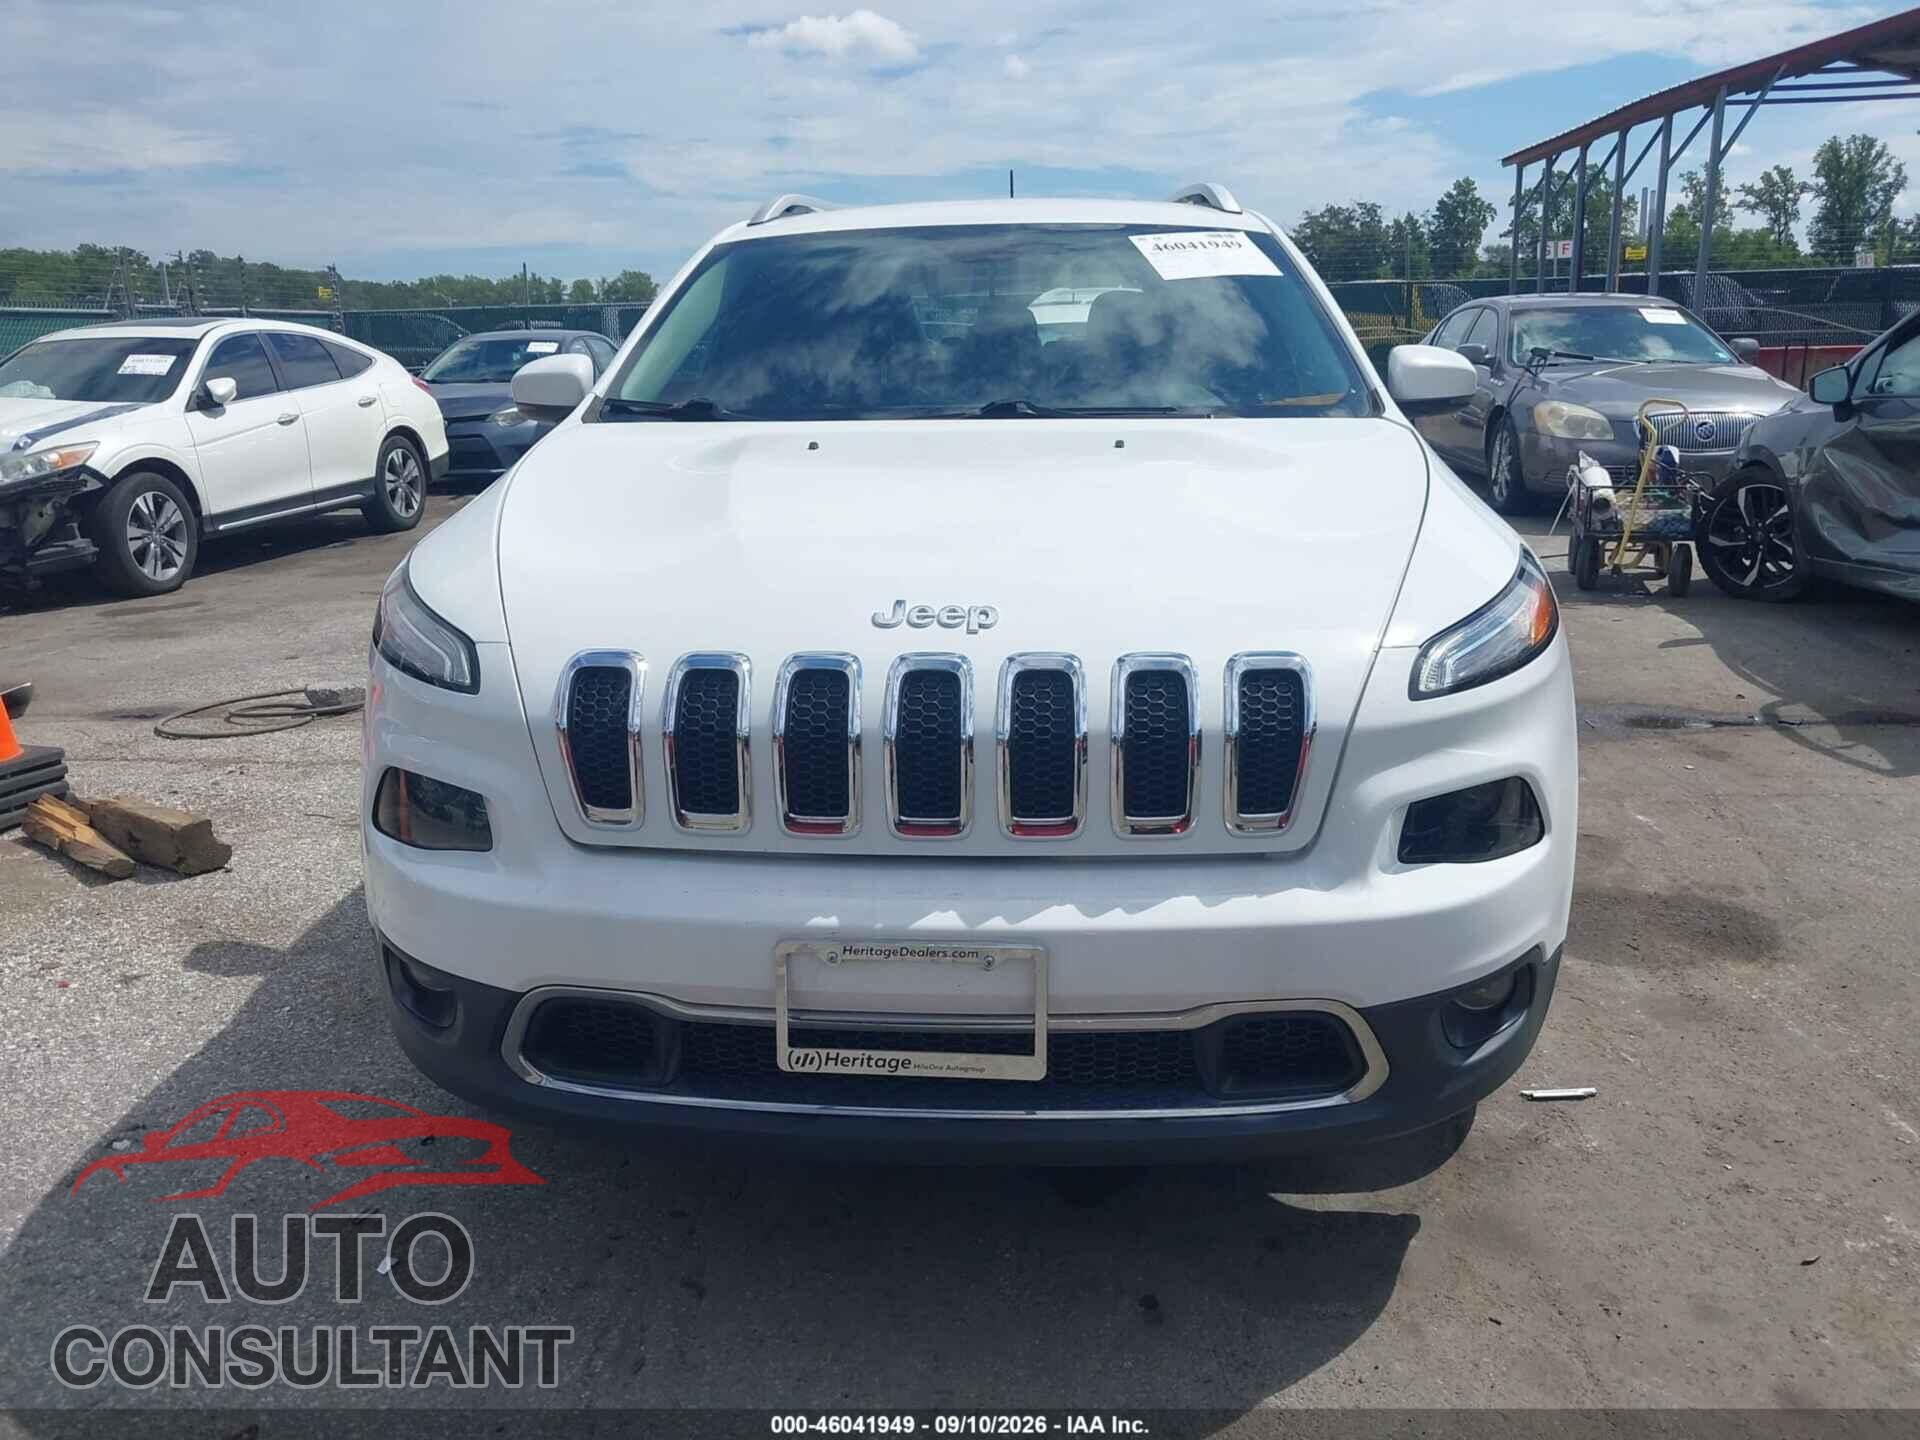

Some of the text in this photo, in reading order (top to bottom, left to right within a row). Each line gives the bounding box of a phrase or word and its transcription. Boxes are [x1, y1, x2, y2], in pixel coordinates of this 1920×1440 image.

[1152, 240, 1242, 252] 46041949
[871, 599, 999, 635] Jeep
[842, 945, 979, 960] HeritageDealers.com
[824, 1052, 912, 1073] Heritage
